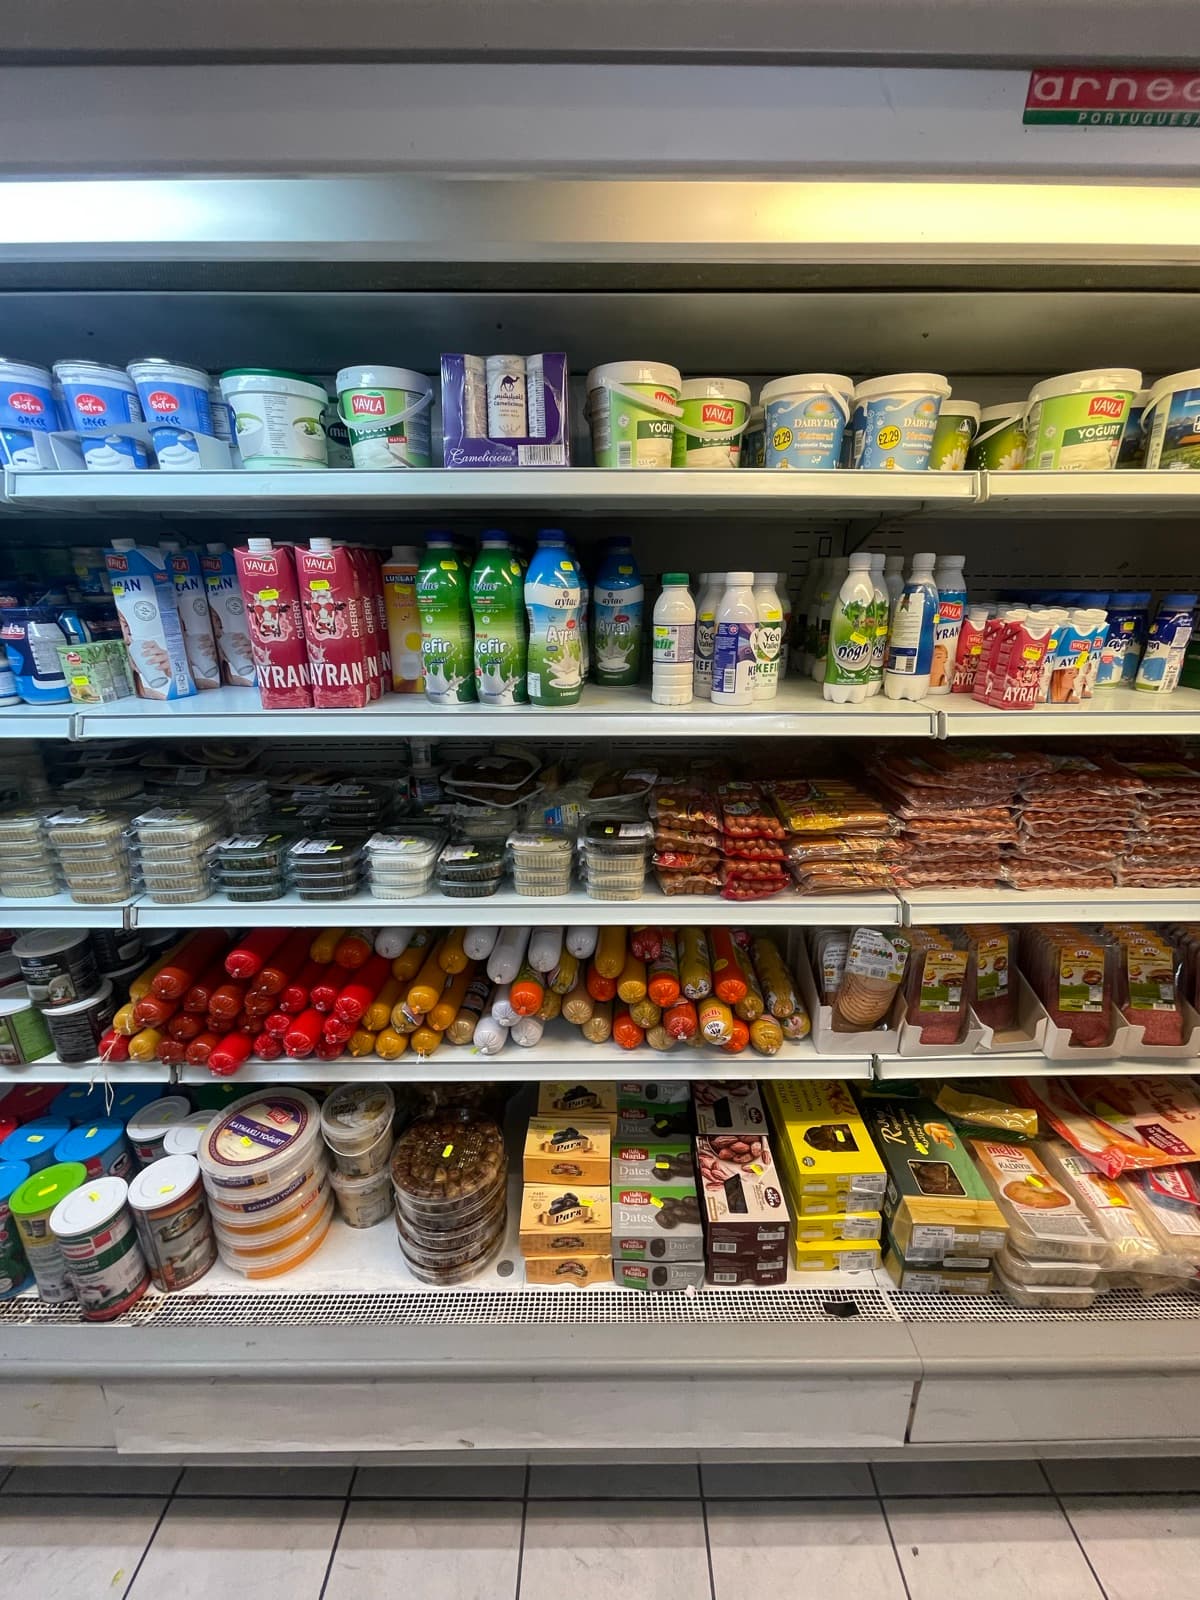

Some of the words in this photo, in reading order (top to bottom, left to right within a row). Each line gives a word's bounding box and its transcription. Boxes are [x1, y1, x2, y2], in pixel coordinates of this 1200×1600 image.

[794, 418, 822, 428] DAIRY
[773, 430, 791, 447] £2.29
[878, 429, 899, 446] £2.29
[449, 448, 513, 464] Camelicious
[292, 600, 305, 639] CHERRY
[348, 597, 360, 638] CHERRY
[362, 596, 375, 634] CHERRY
[765, 631, 780, 642] Yeo
[756, 662, 778, 673] KEFI
[556, 1141, 582, 1152] Pars
[620, 1166, 650, 1176] Dates
[555, 1209, 582, 1224] Pars
[620, 1211, 654, 1223] Dates
[669, 1240, 696, 1250] Dates
[671, 1270, 697, 1278] Dates
